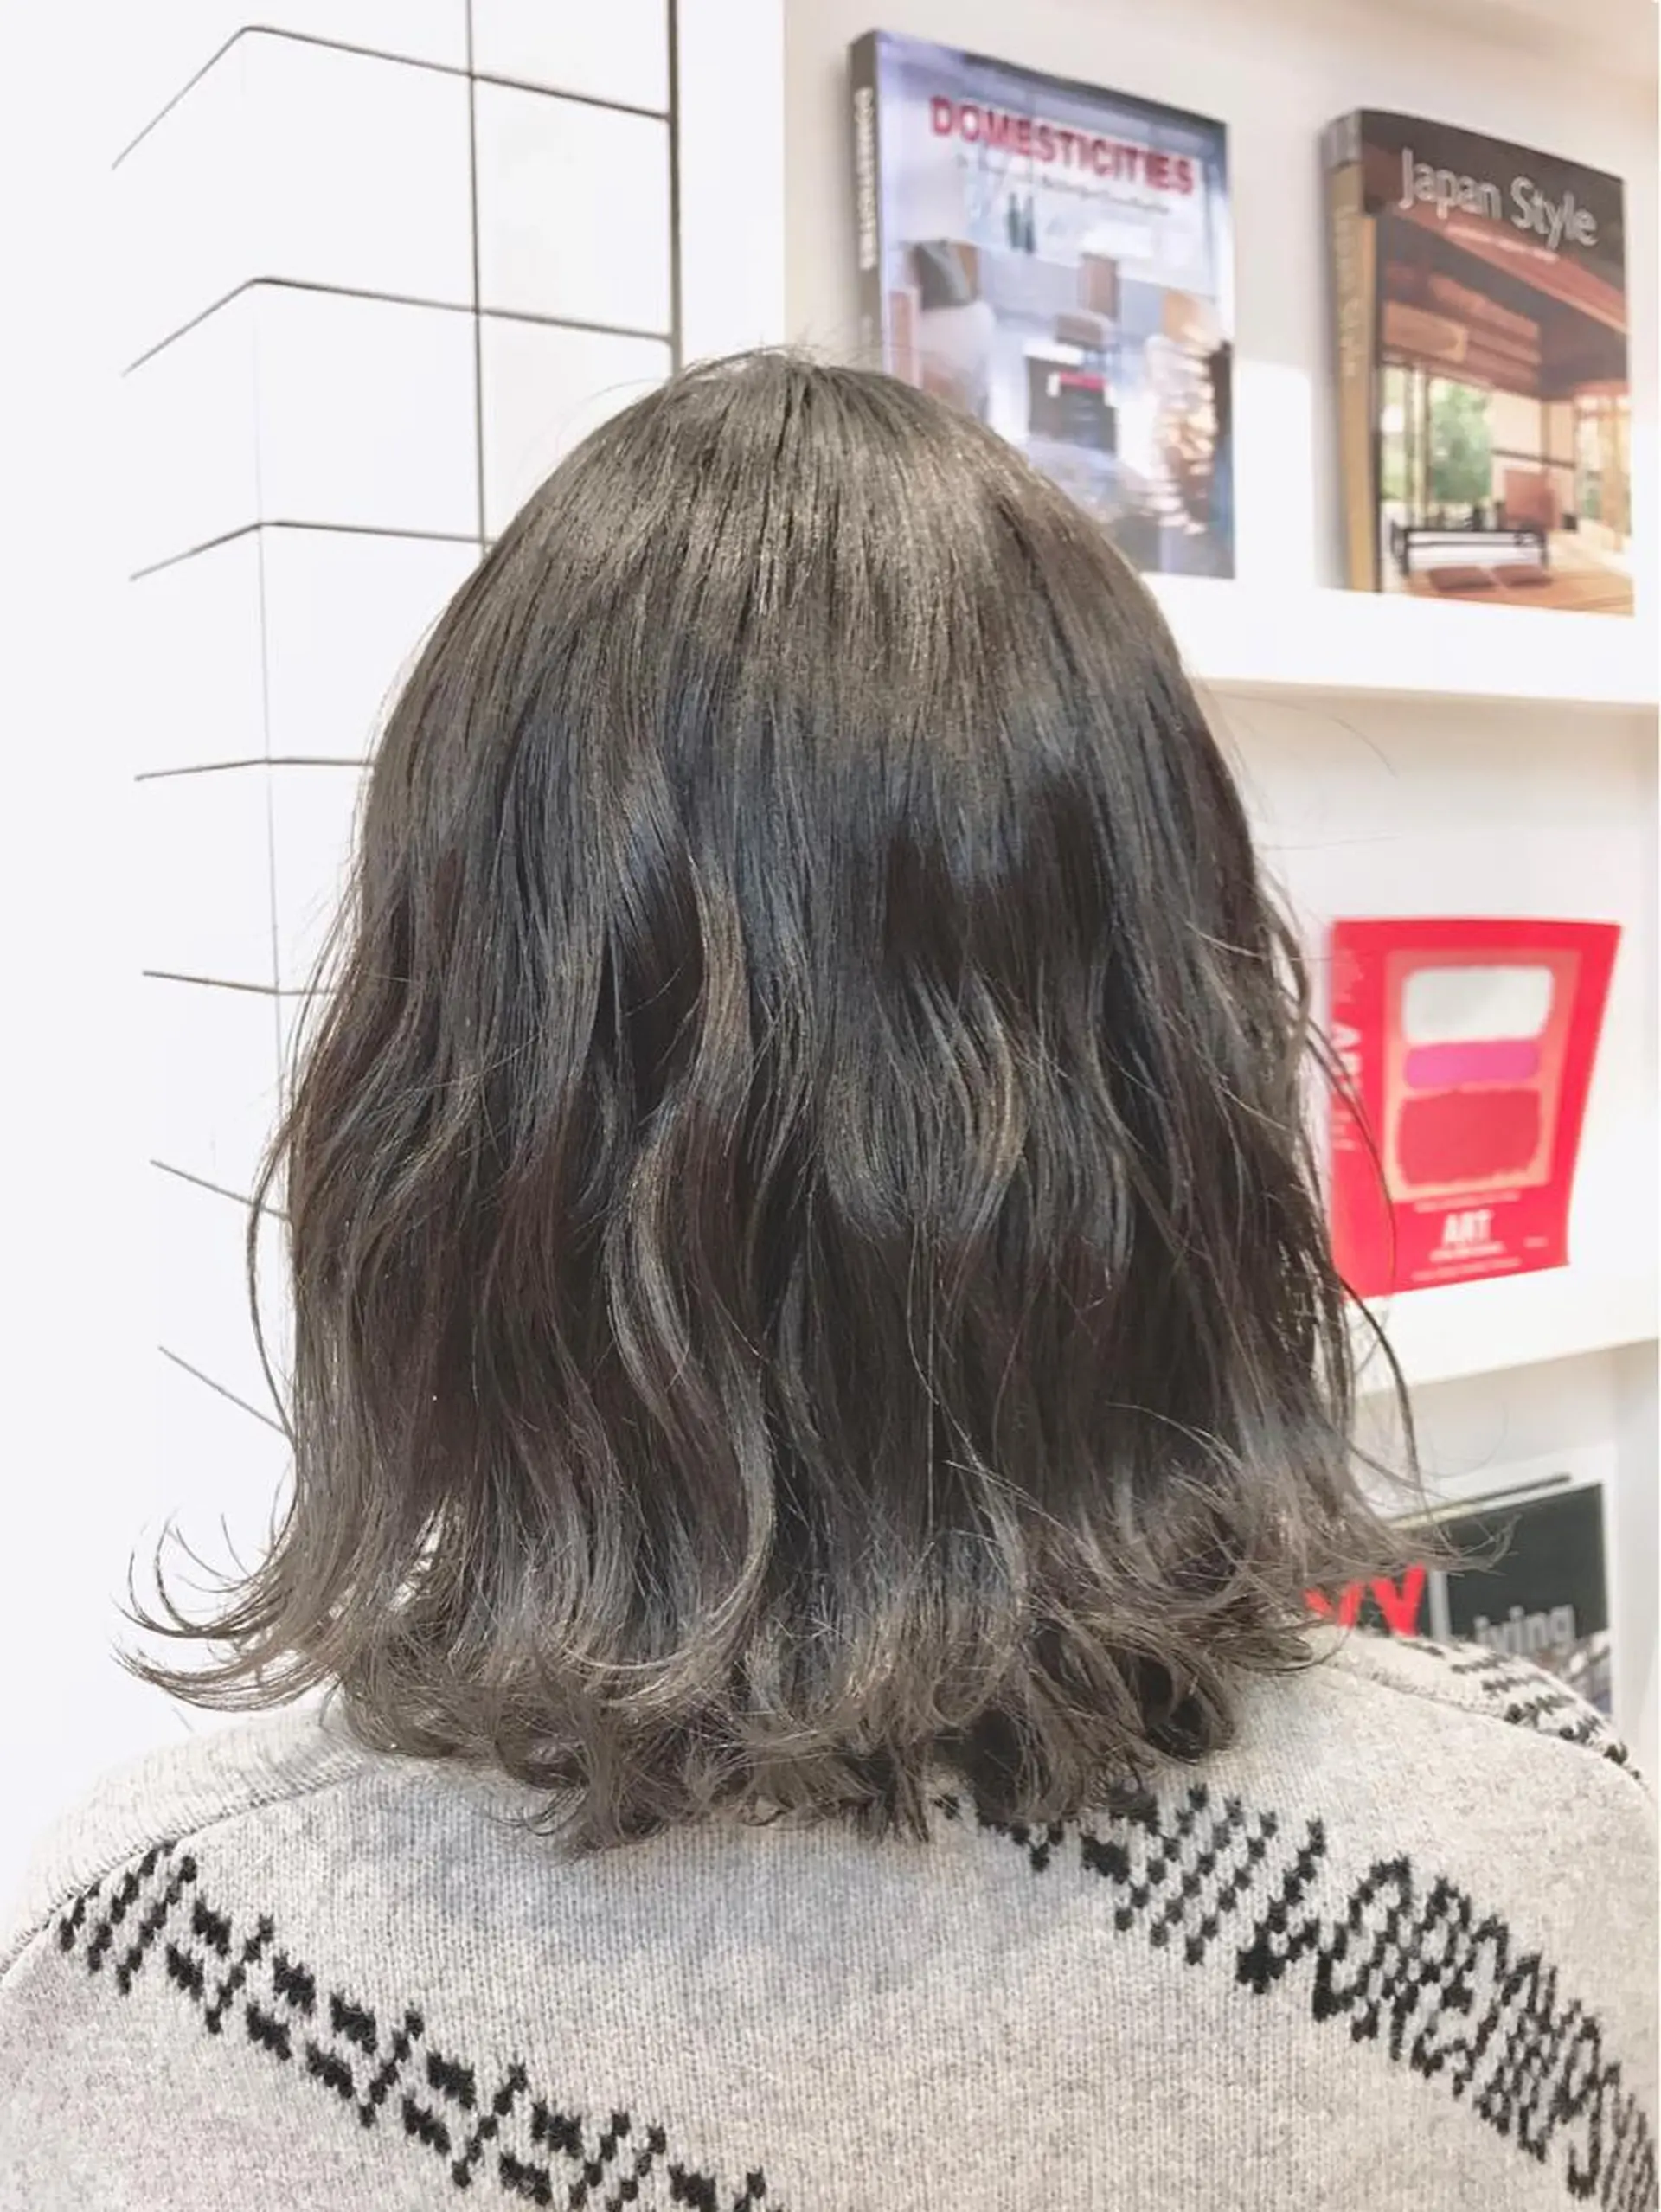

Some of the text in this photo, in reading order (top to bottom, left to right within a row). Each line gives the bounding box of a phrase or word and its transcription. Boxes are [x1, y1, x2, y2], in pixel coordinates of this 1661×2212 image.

[930, 94, 1195, 195] DOMESTICITIES
[1398, 146, 1502, 220] Japan
[1510, 175, 1599, 251] Style
[1441, 1209, 1495, 1247] ART
